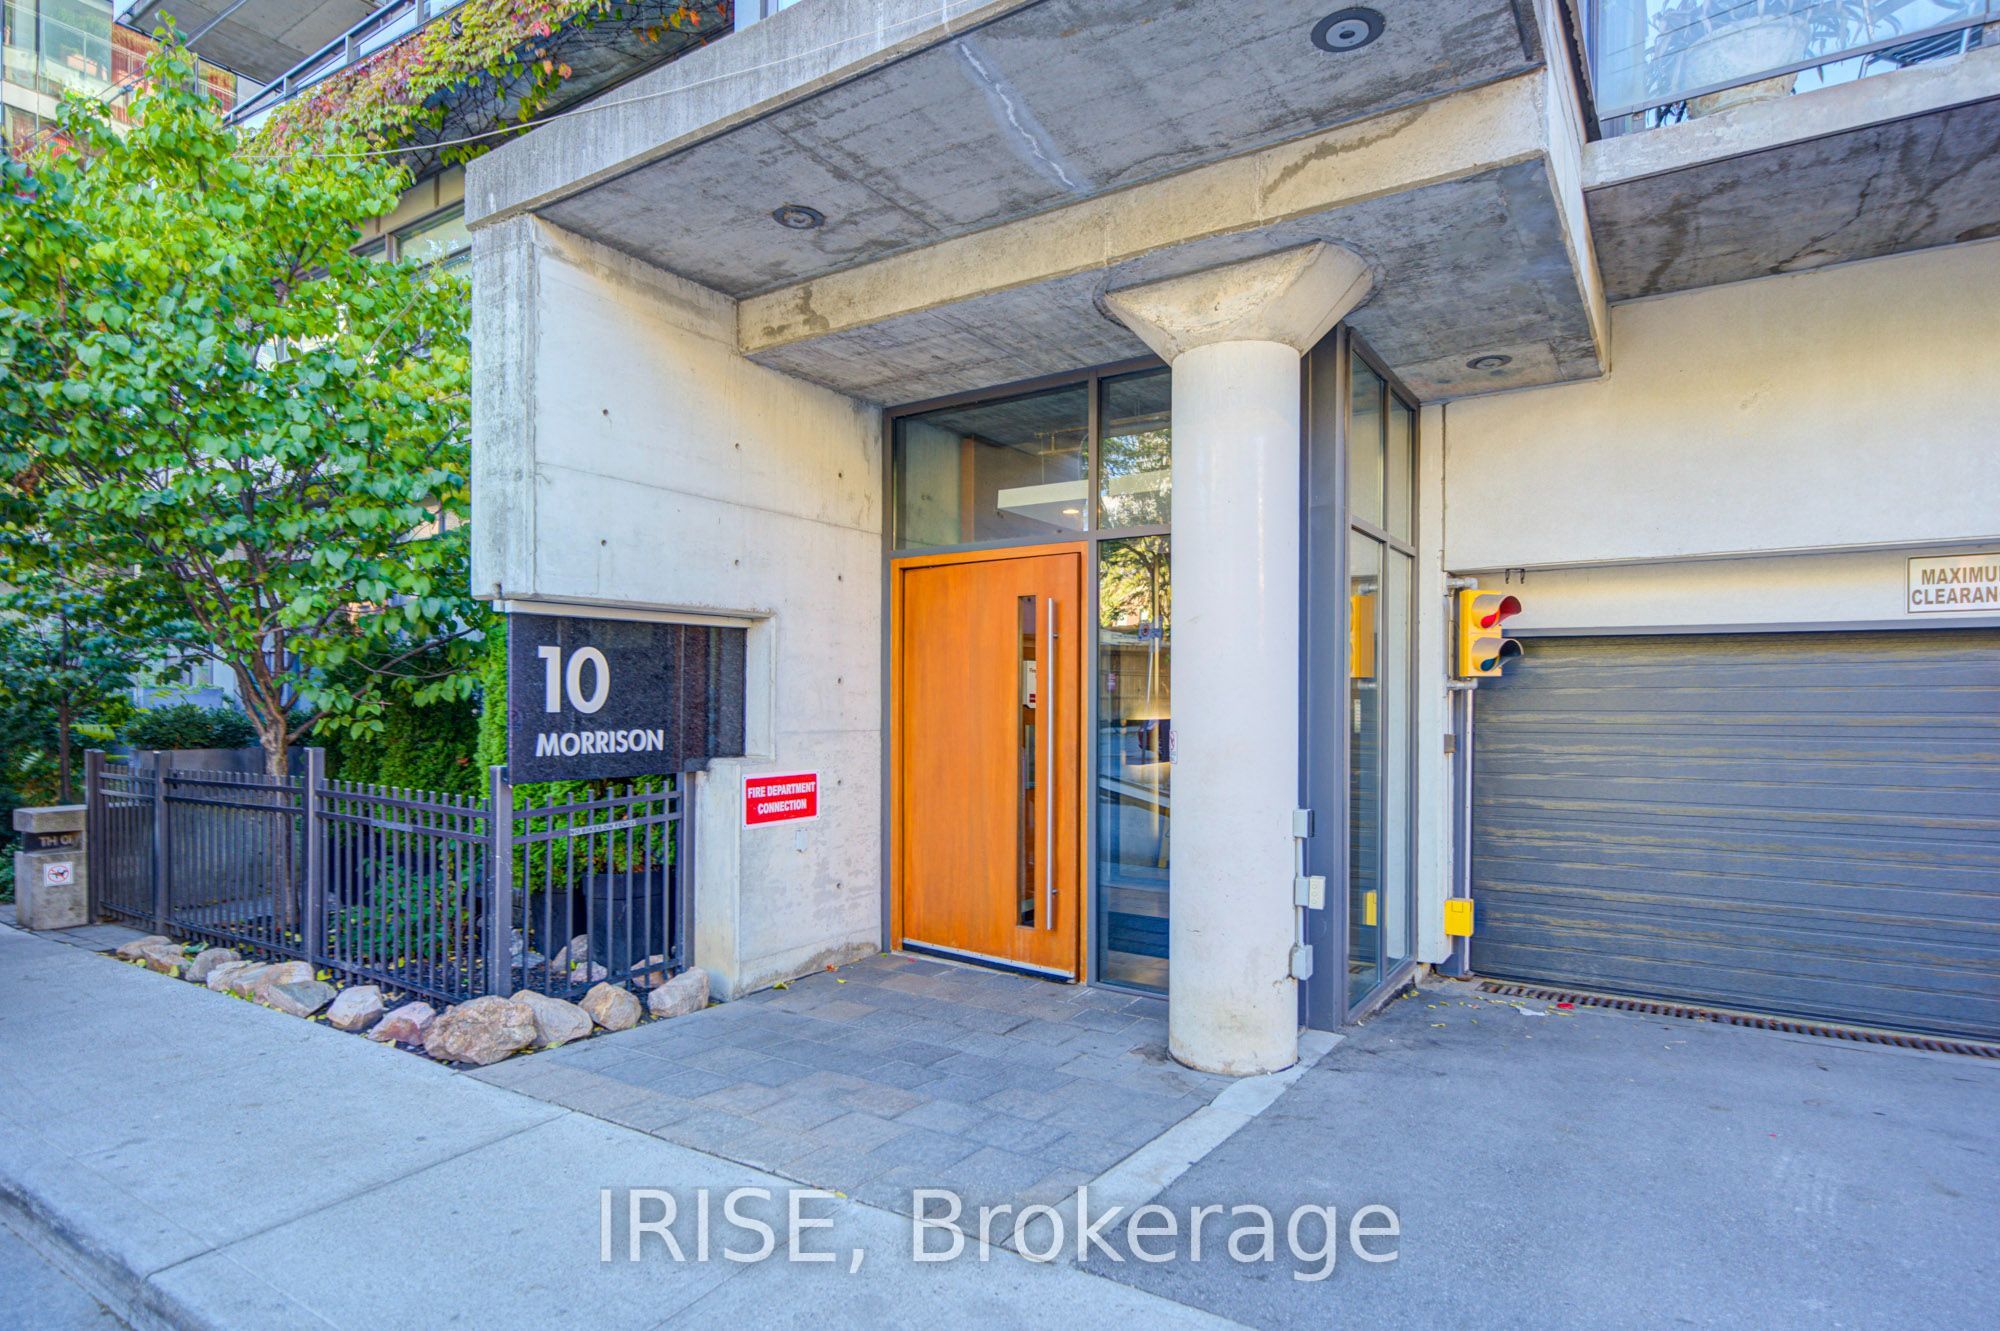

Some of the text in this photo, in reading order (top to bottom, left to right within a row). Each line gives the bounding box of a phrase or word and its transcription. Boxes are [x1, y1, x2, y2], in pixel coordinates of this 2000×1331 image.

[1921, 566, 2000, 585] MAXIMU
[1911, 586, 2000, 605] CLEARAN
[538, 646, 610, 713] 10
[536, 729, 664, 757] MORRISON
[748, 782, 815, 799] FIRE DEPARTMENT
[758, 799, 807, 814] CONNECTION
